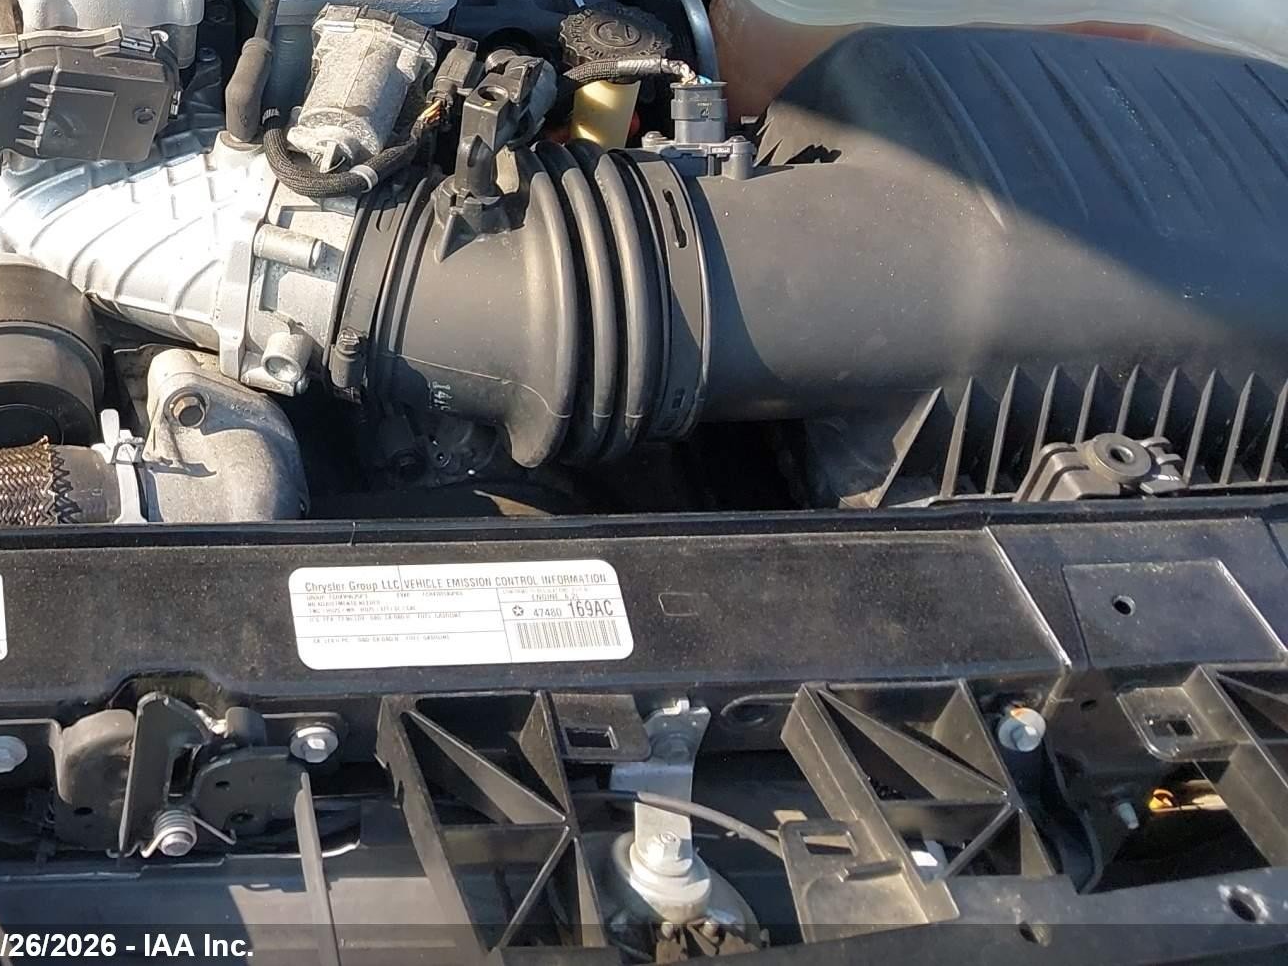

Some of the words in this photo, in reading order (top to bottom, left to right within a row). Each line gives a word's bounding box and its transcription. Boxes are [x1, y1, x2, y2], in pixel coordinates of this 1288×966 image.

[305, 581, 345, 593] Chrysler
[349, 581, 378, 592] Group
[381, 580, 400, 590] LLC
[403, 579, 441, 589] VEHICLE
[446, 577, 492, 588] EMISSION
[495, 575, 536, 586] CONTROL
[541, 574, 606, 585] INFORMATION
[533, 608, 562, 617] 47480
[568, 599, 614, 617] 169AC
